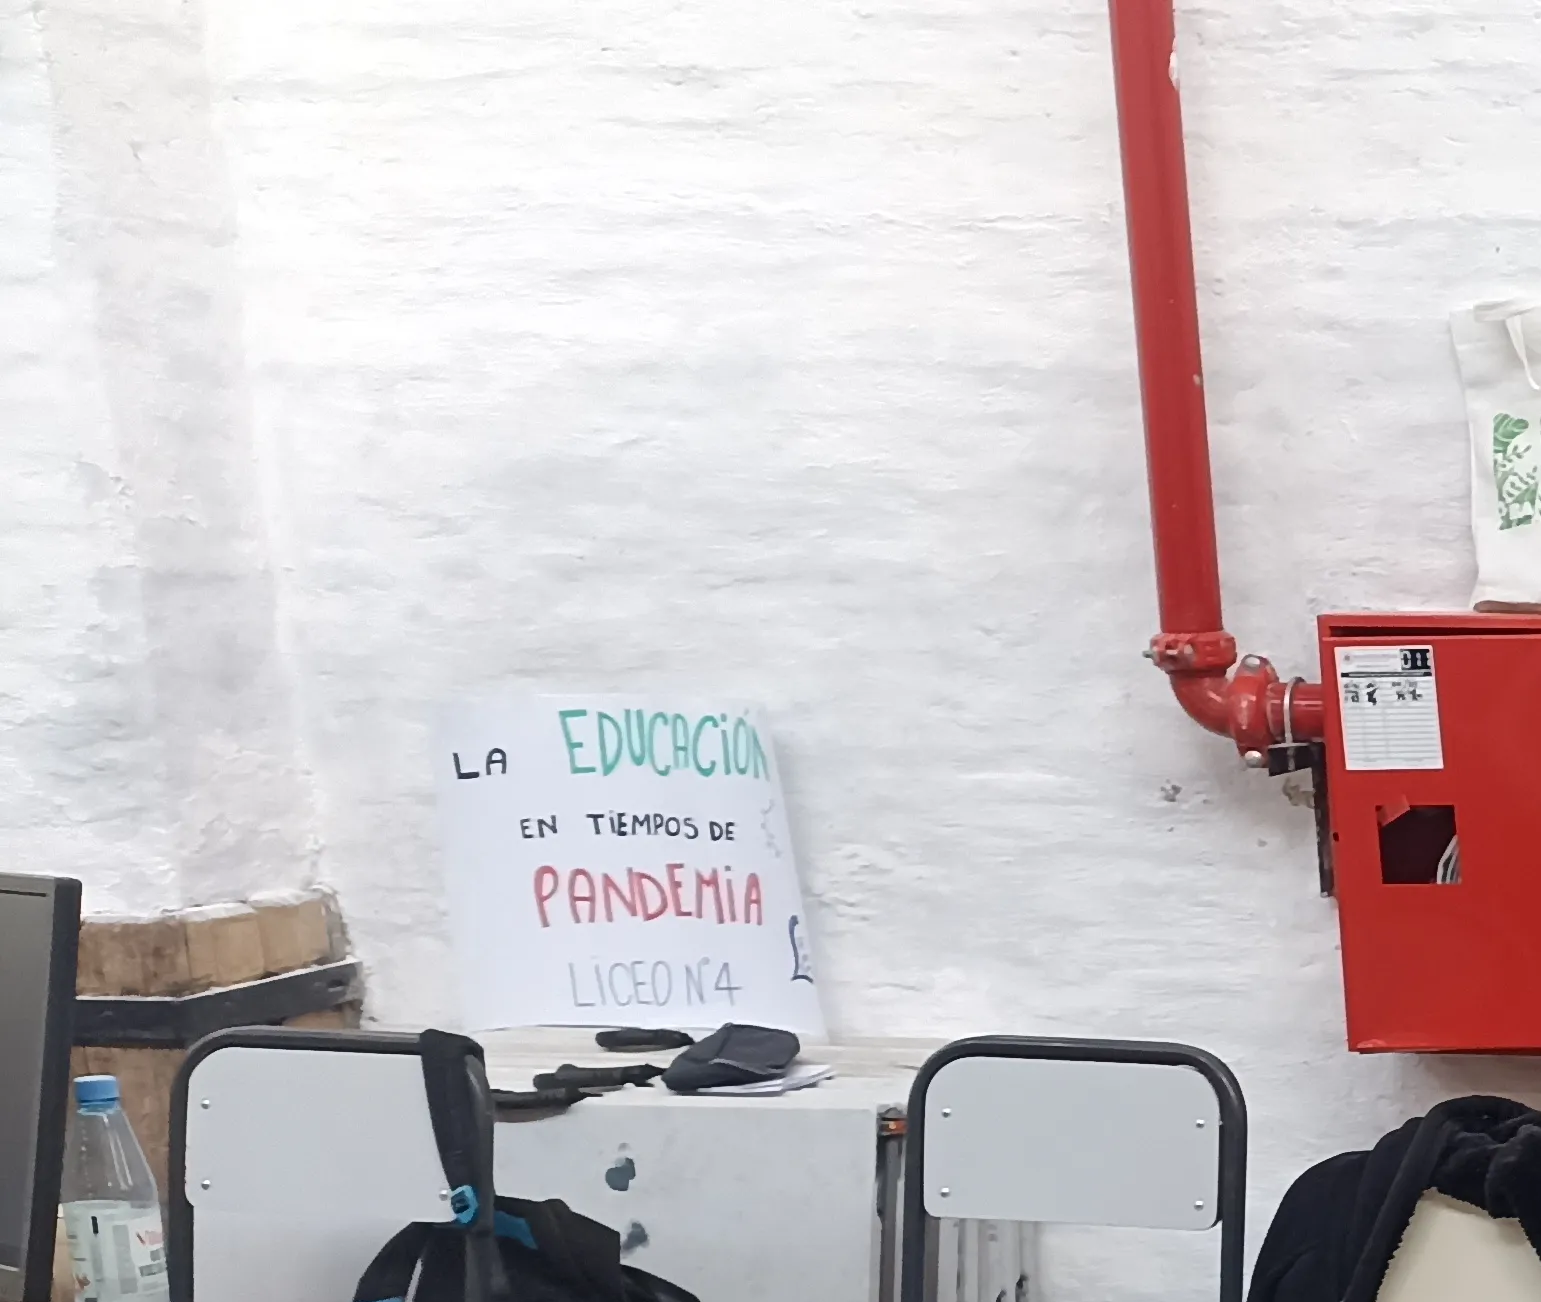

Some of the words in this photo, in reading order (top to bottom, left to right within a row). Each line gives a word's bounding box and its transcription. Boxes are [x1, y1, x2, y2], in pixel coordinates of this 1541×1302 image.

[452, 747, 508, 780] LA
[519, 814, 559, 840] EN
[709, 820, 736, 842] DE
